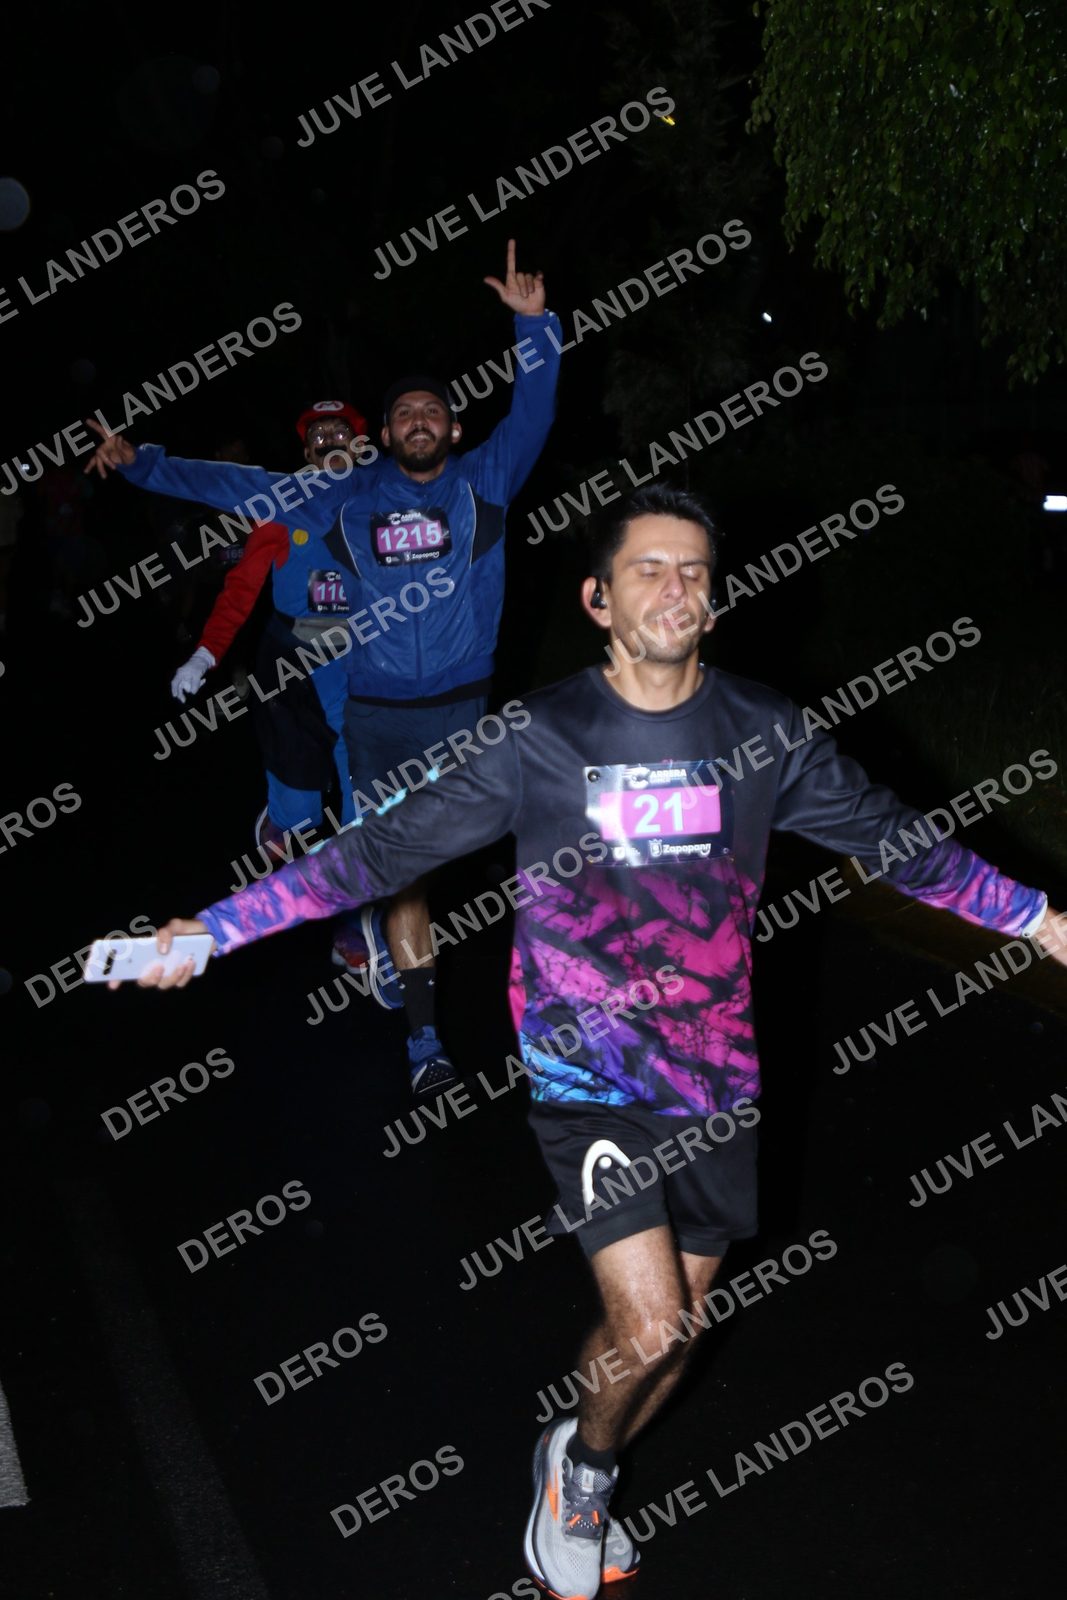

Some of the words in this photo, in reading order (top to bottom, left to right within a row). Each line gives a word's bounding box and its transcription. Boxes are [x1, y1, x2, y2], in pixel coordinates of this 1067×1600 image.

[381, 523, 441, 551] 1215
[633, 792, 684, 834] 21
[663, 844, 711, 857] Zapopan
